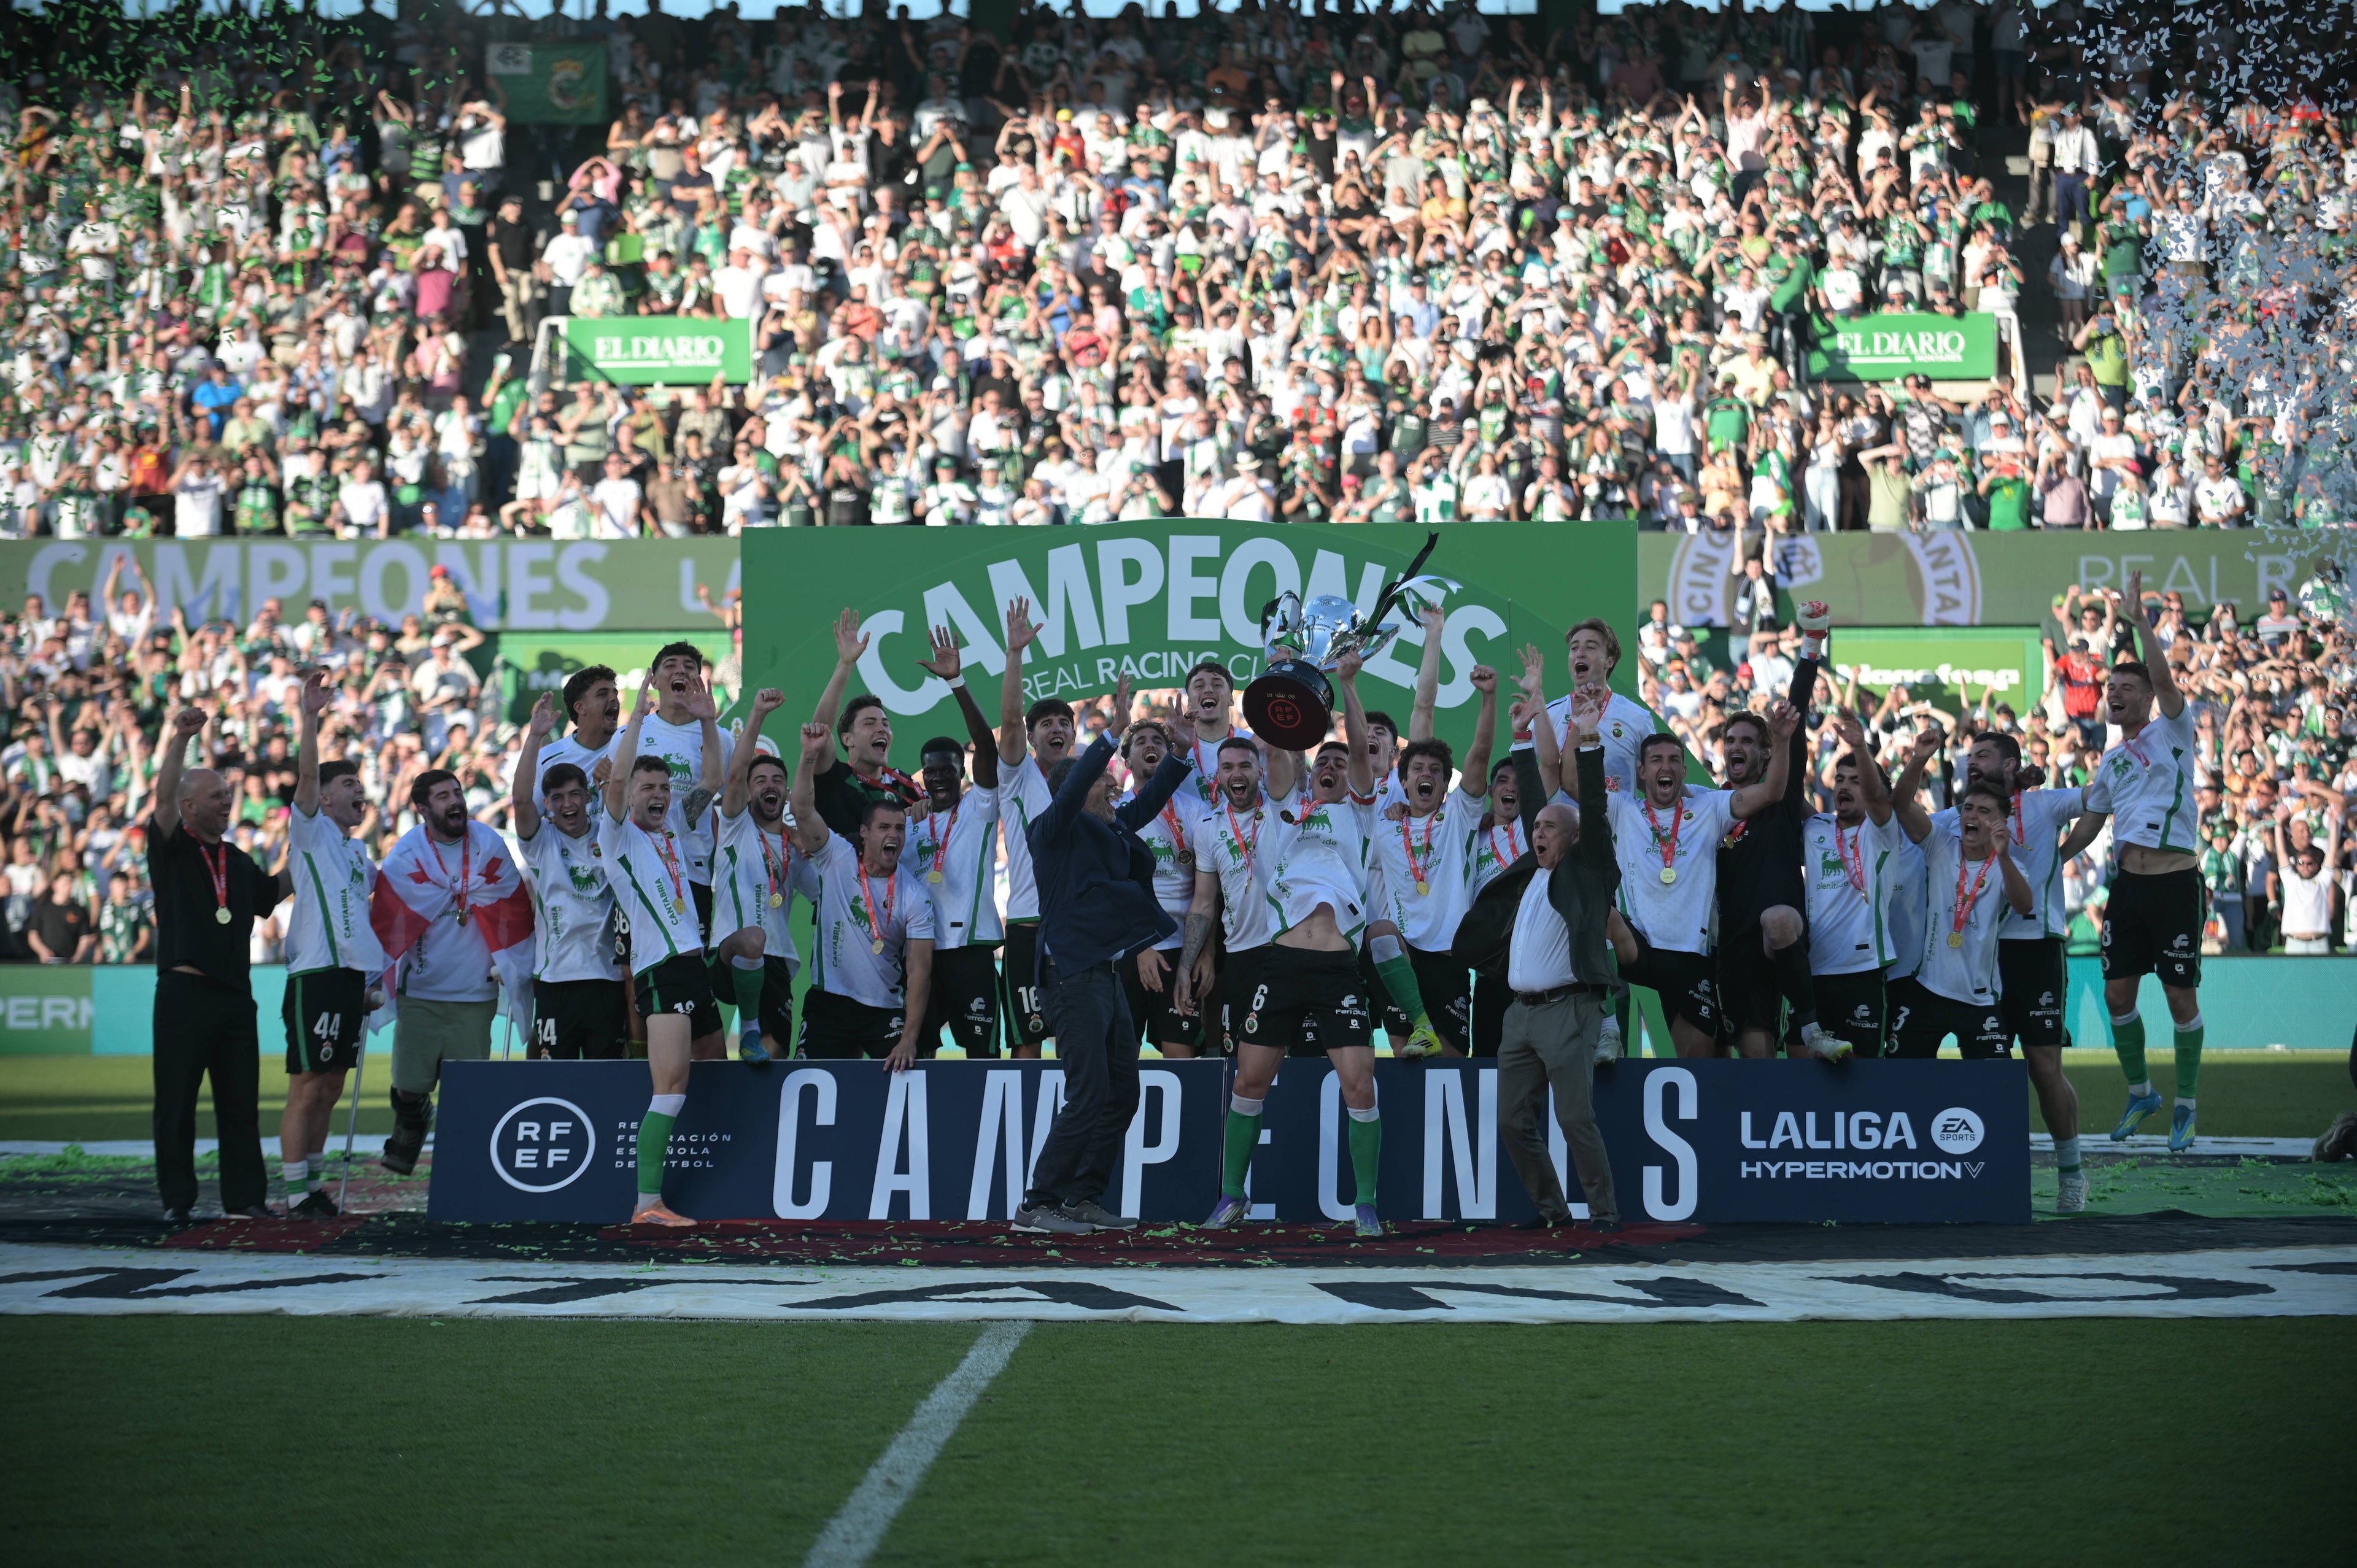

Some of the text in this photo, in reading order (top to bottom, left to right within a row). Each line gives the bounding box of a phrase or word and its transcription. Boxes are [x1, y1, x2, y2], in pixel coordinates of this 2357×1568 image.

[595, 335, 725, 359] EL DIARIO
[1836, 331, 1965, 356] EL DIARIO
[26, 541, 610, 631] CAMPEONES
[2079, 555, 2242, 605] REAL
[856, 535, 1507, 716] CAMPEONES
[1023, 651, 1258, 705] REAL RACING CL
[670, 782, 692, 792] nitude
[1296, 835, 1337, 846] plenude
[1646, 846, 1687, 857] pleude
[341, 888, 351, 938] CANTABRIA
[655, 879, 678, 925] CANTABRIA
[614, 906, 630, 935] 36
[2102, 920, 2111, 947] 8
[416, 935, 424, 975] CANTABR
[1017, 985, 1042, 1014] 16
[1252, 983, 1268, 1011] 6
[314, 1011, 341, 1041] 44
[1335, 1008, 1368, 1017] Ferroluz
[536, 1018, 557, 1046] 34
[517, 1121, 572, 1141] RF
[617, 1133, 732, 1142] FERACIÓN
[1741, 1111, 1917, 1149] LALIGA
[1940, 1118, 1975, 1134] EA
[616, 1146, 710, 1155] ESÑOLA
[772, 1066, 1699, 1221] CAMPONS
[514, 1148, 570, 1168] EF
[1741, 1162, 1961, 1179] HYPERMOTION
[0, 1261, 2357, 1311] NTAND
